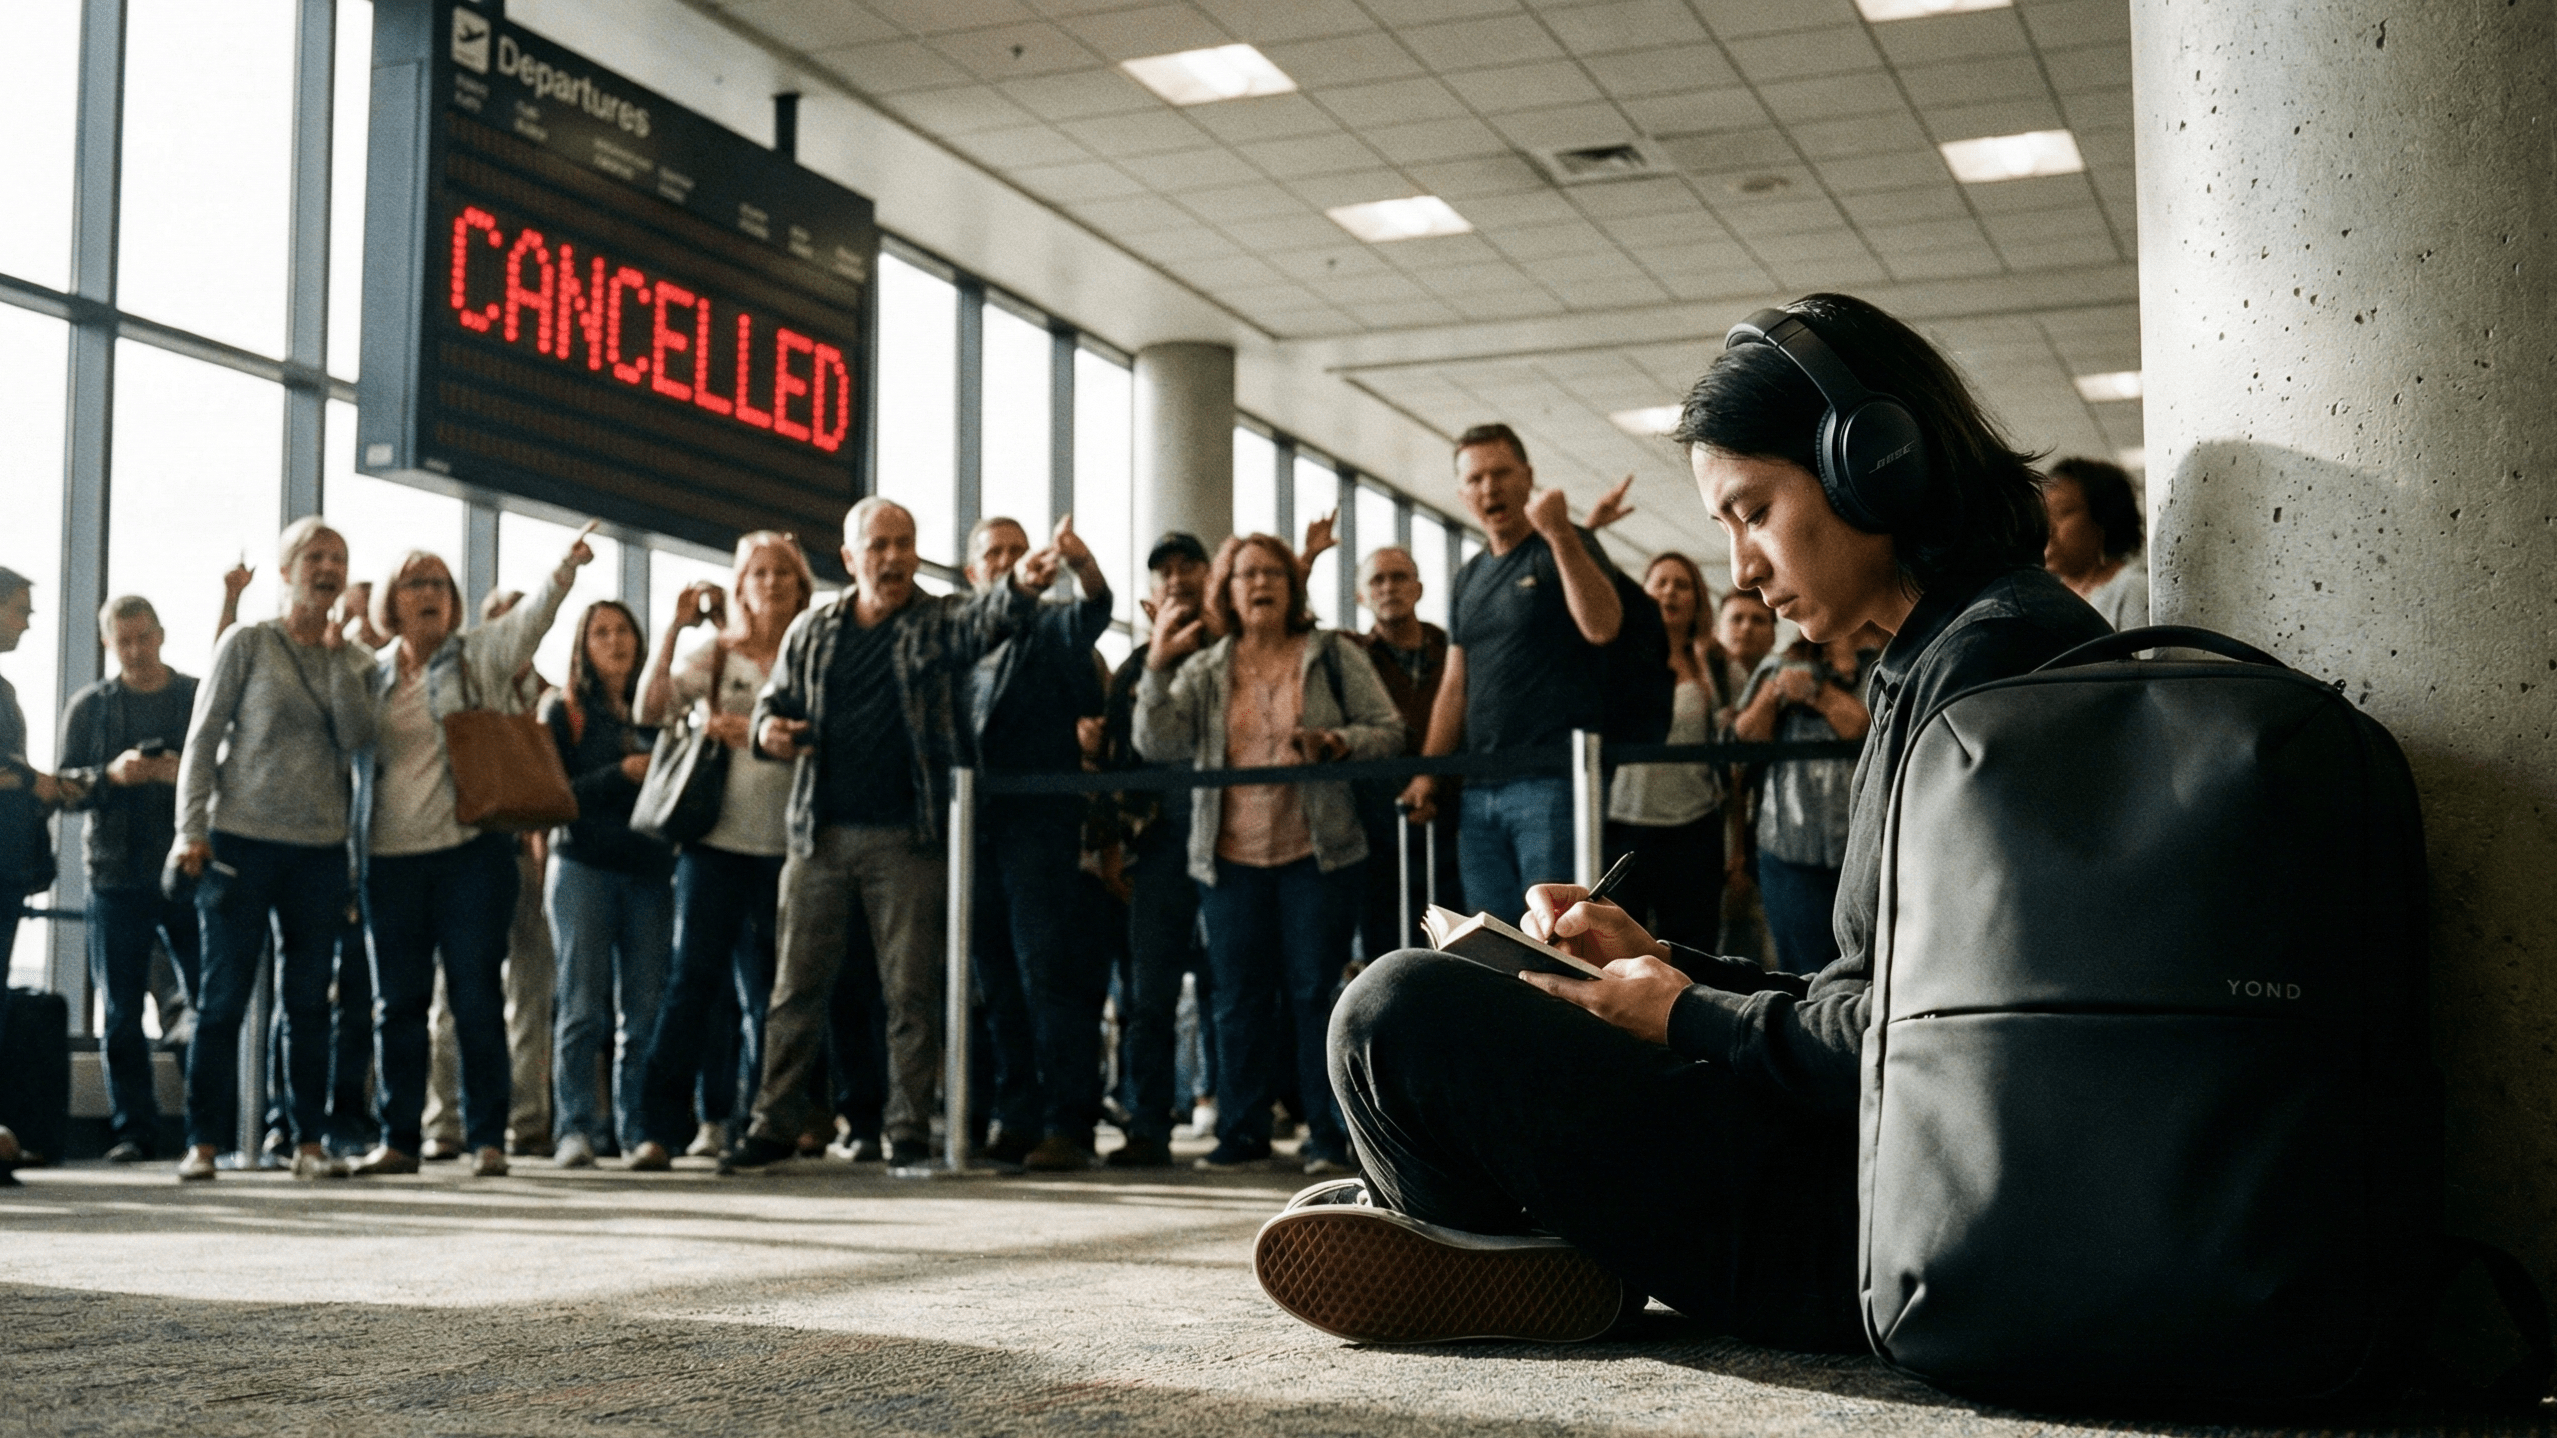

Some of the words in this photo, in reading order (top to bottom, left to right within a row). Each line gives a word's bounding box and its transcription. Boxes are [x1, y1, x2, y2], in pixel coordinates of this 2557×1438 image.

[498, 34, 649, 138] Departures
[450, 206, 850, 453] CANCELLED
[2227, 979, 2301, 999] YOND
